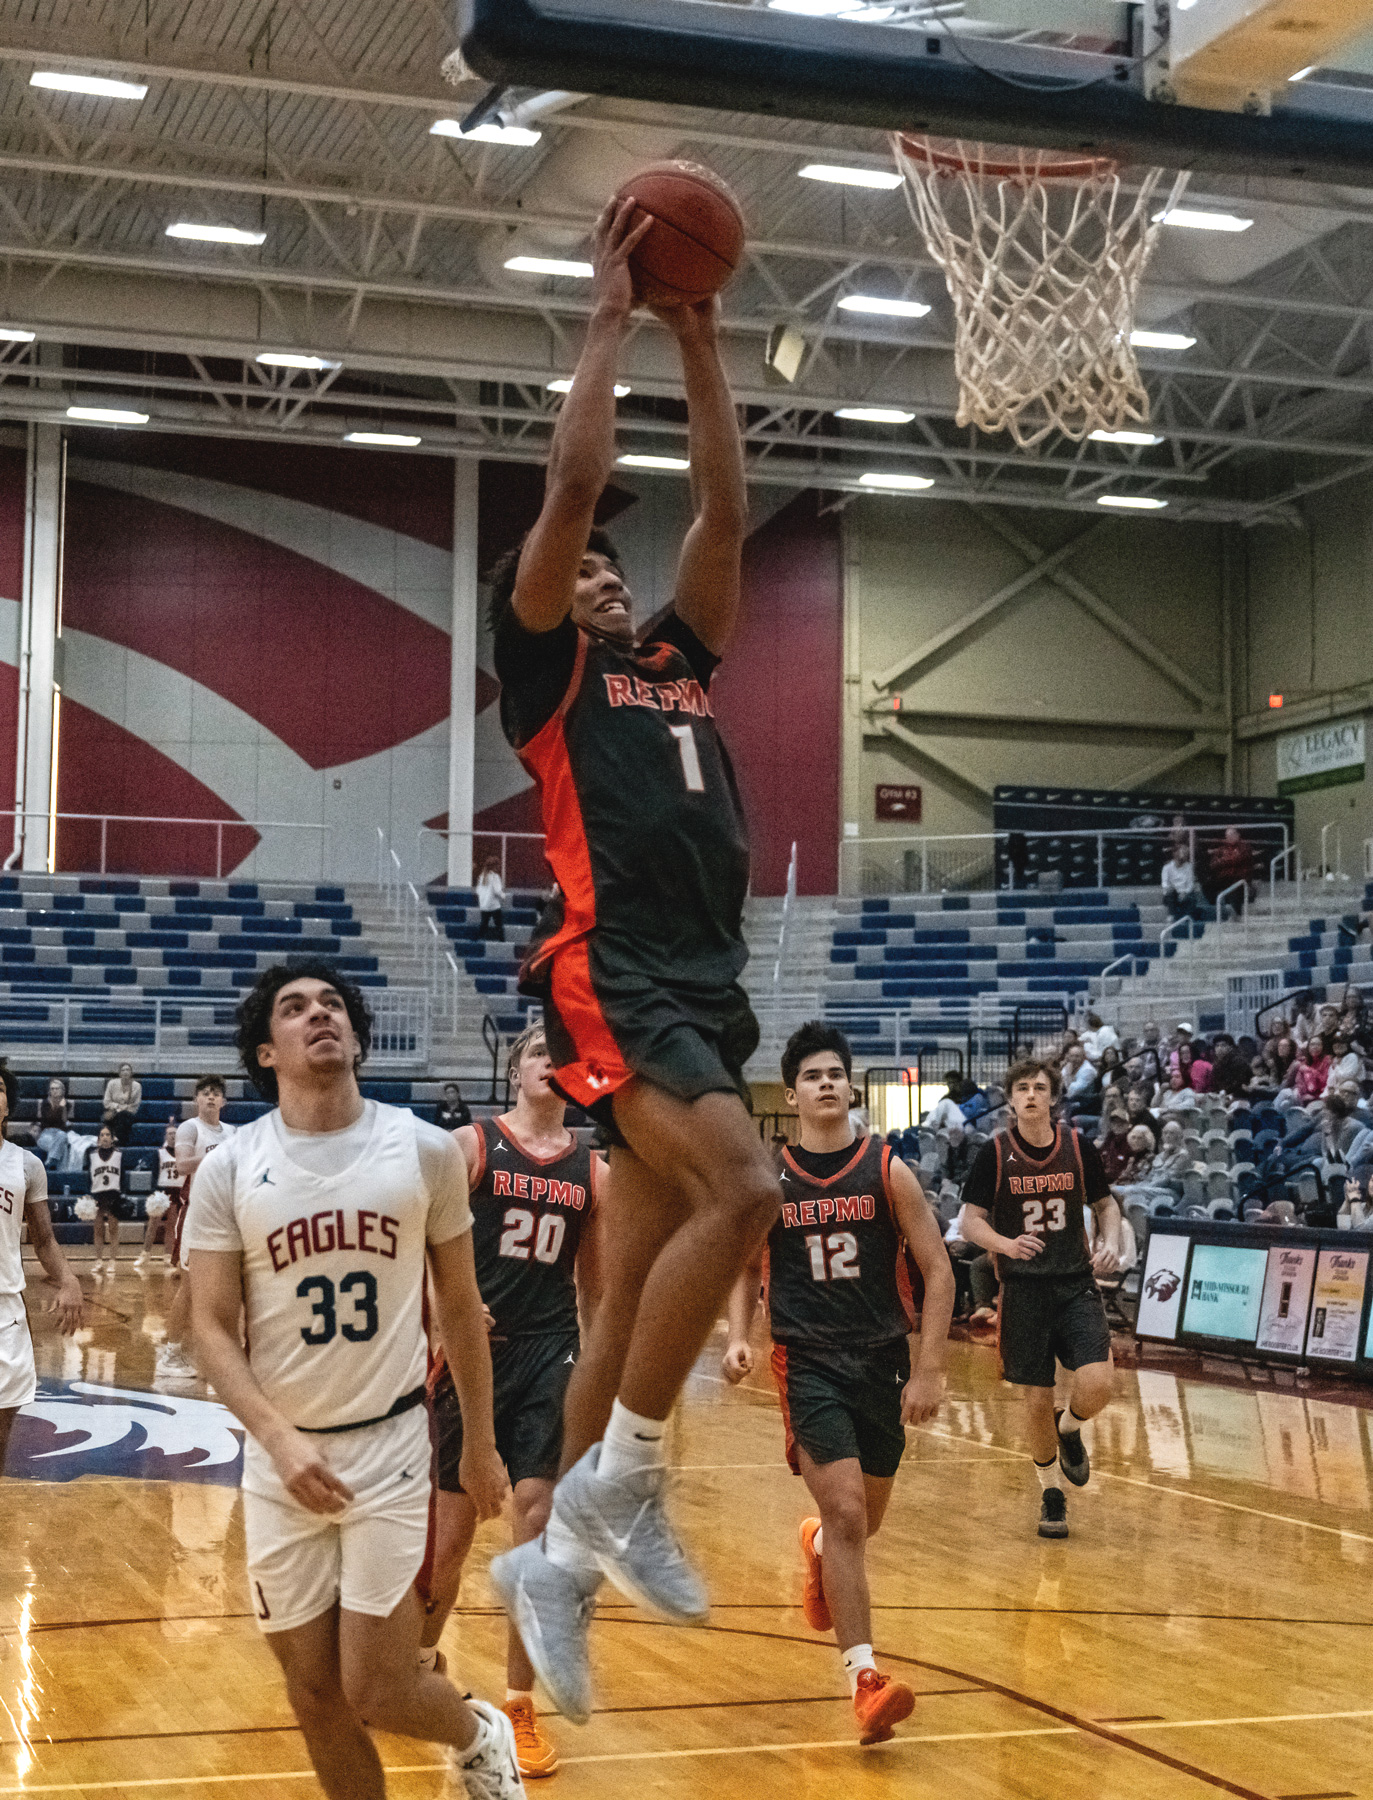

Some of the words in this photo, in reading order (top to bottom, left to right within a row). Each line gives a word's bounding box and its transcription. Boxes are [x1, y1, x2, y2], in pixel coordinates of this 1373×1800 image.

[603, 673, 715, 718] REPM
[670, 724, 705, 791] 1
[1305, 724, 1360, 755] LEGACY
[93, 1165, 120, 1177] JOPLIN
[493, 1170, 586, 1211] REPMO
[1008, 1172, 1075, 1195] REPMO
[781, 1194, 876, 1229] REPMO
[1022, 1198, 1067, 1233] 23
[267, 1209, 400, 1273] EAGLES
[500, 1207, 566, 1266] 20
[804, 1231, 861, 1281] 12
[1329, 1255, 1357, 1270] Thanks
[296, 1270, 379, 1346] 33
